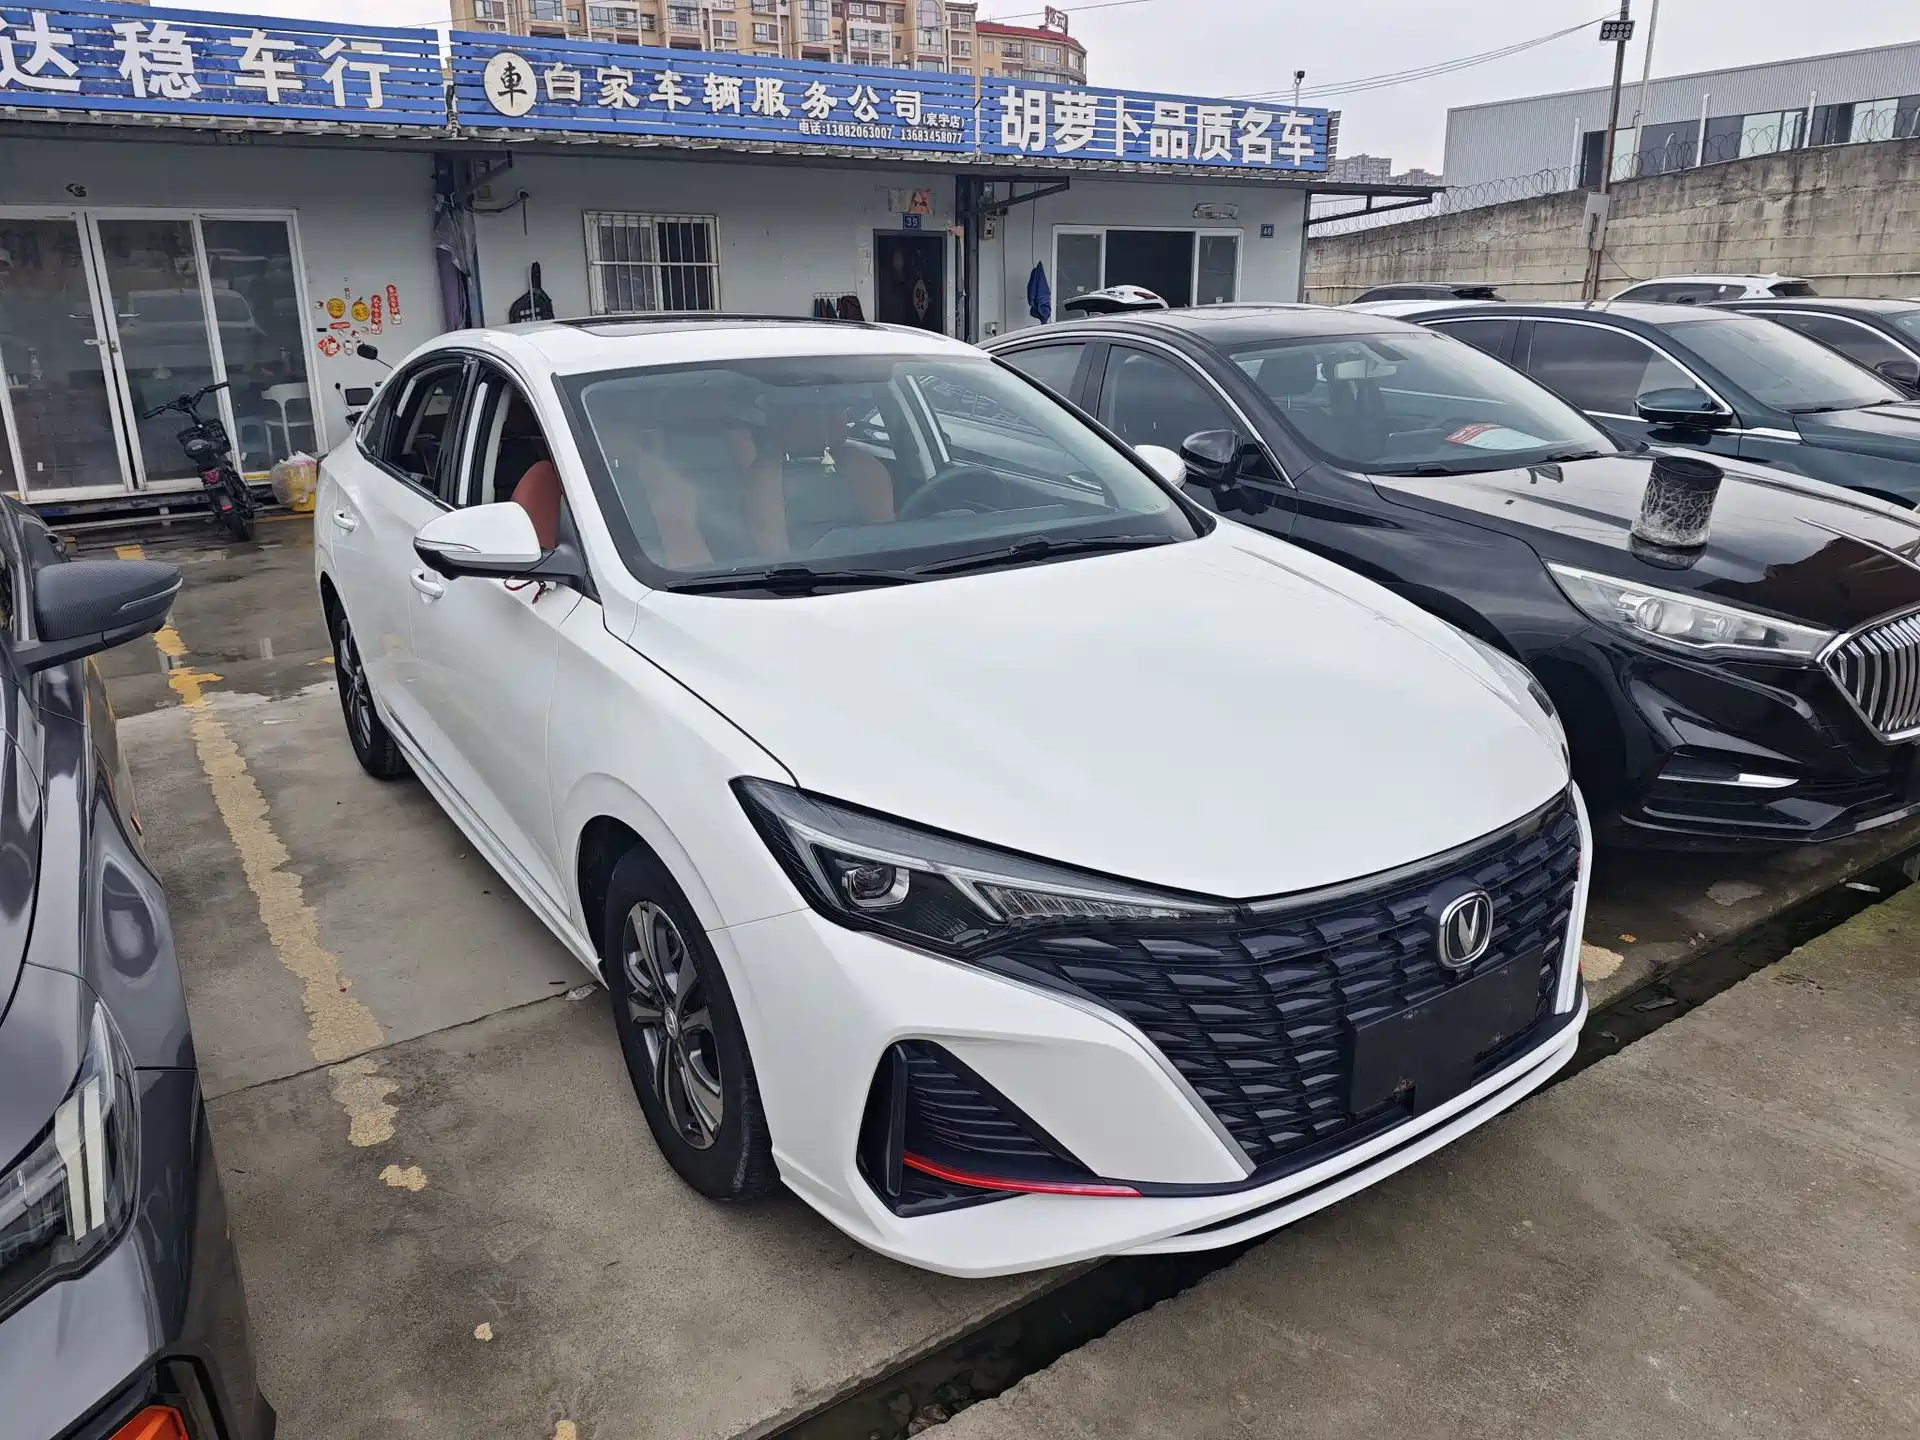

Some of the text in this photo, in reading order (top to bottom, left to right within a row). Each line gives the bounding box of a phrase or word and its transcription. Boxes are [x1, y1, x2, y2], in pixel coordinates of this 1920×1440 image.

[0, 12, 390, 109] 达稳车行
[544, 62, 923, 126] 白家车辆服务公司
[900, 128, 963, 144] 13683458077
[1000, 86, 1316, 166] 胡萝卜品质名车
